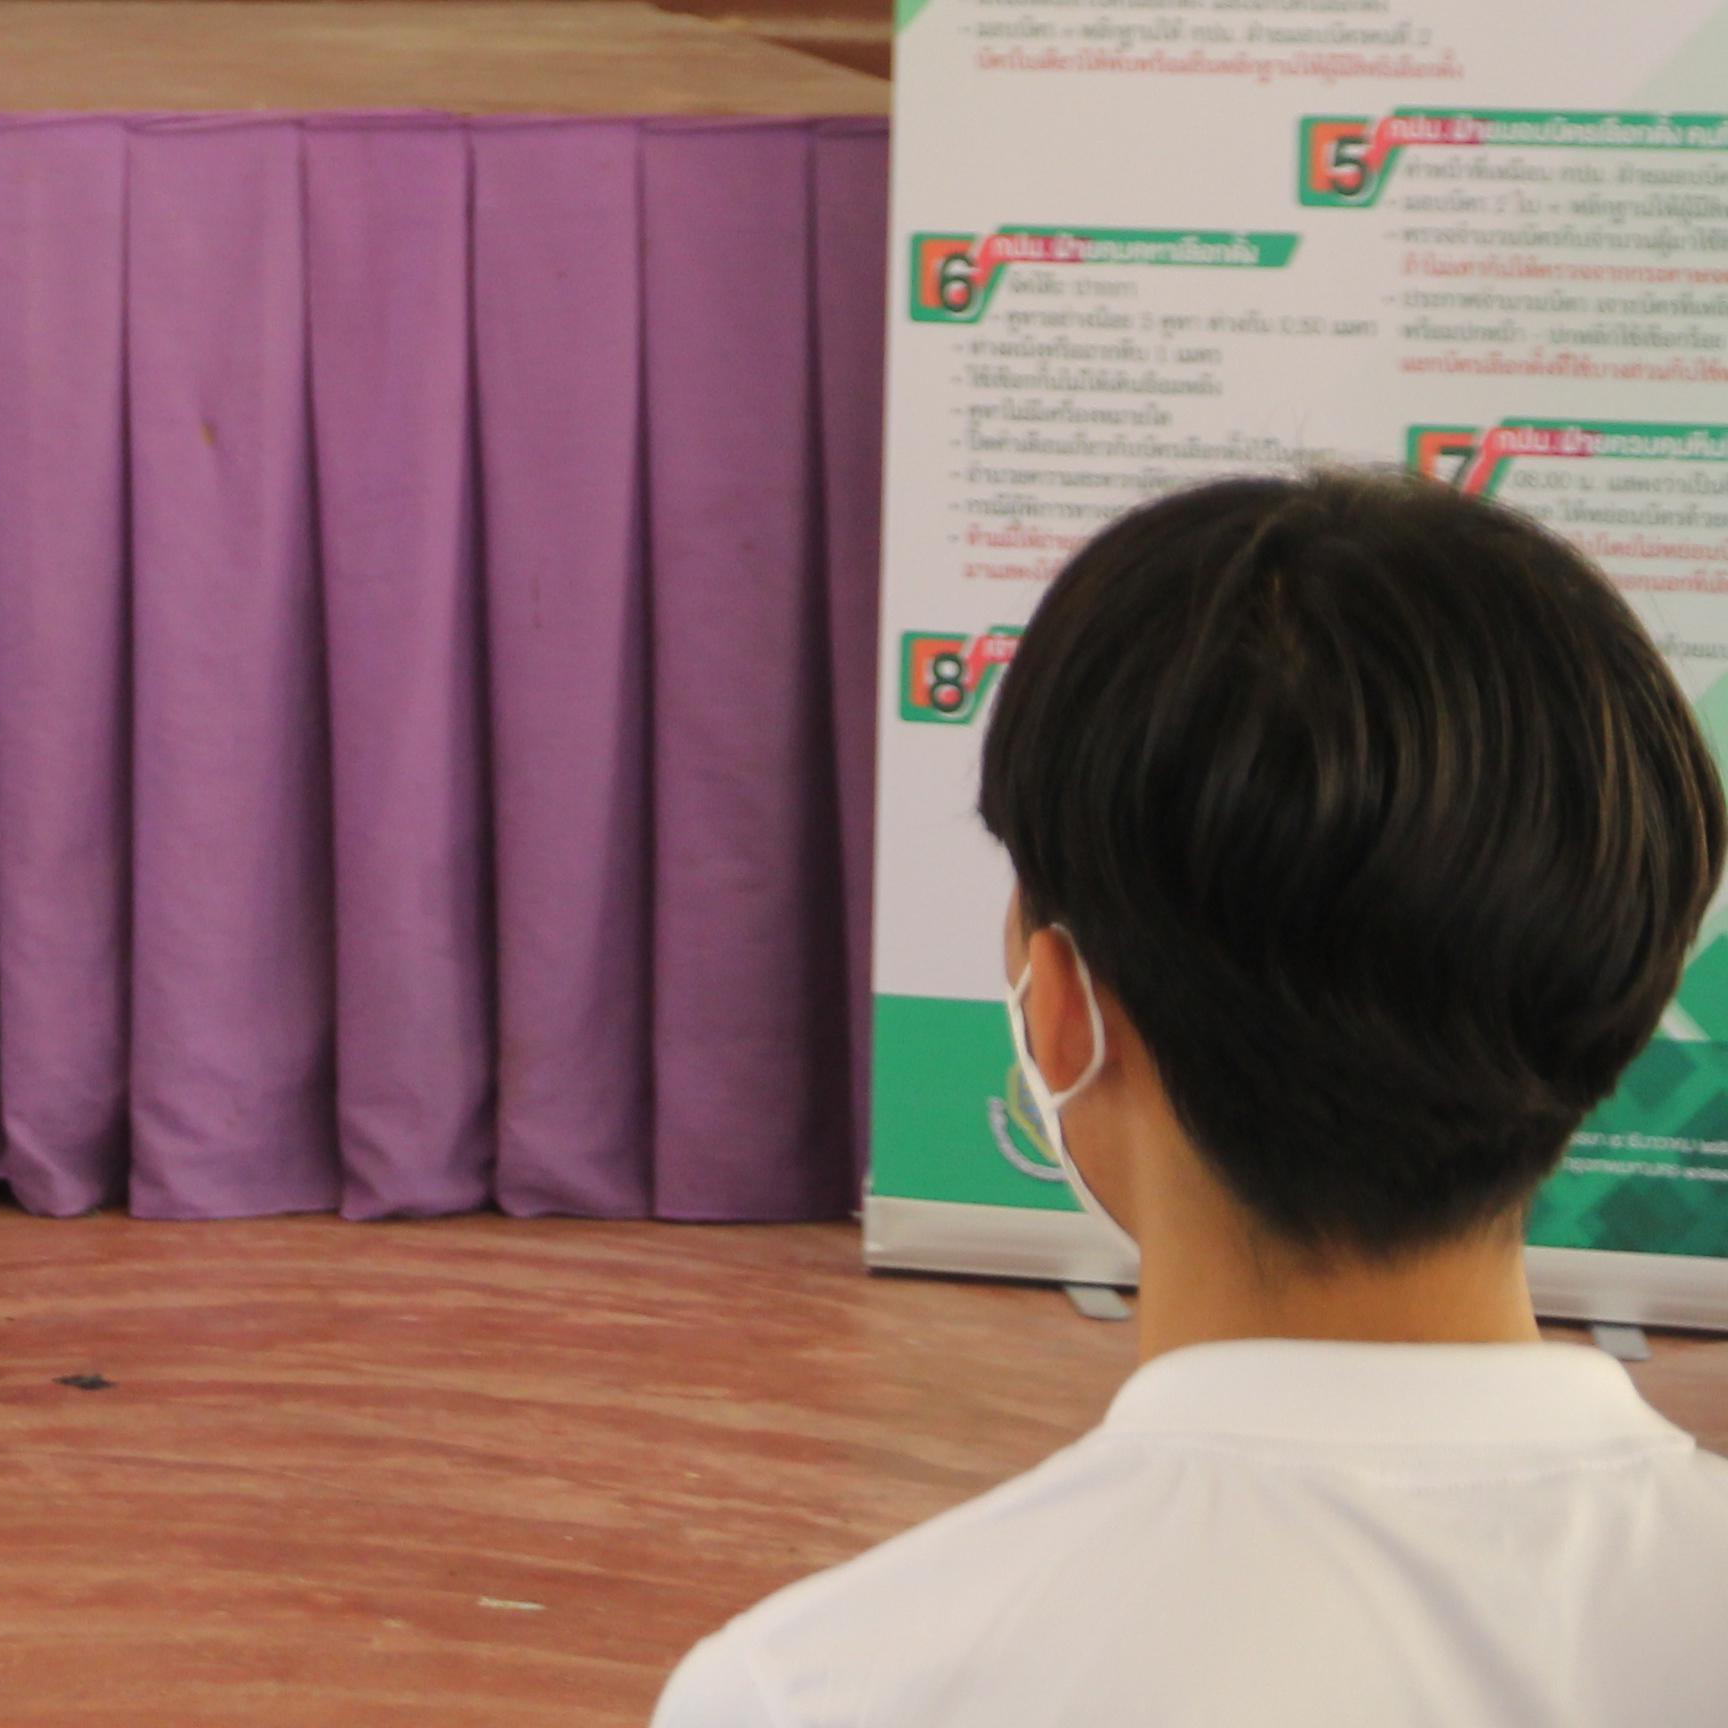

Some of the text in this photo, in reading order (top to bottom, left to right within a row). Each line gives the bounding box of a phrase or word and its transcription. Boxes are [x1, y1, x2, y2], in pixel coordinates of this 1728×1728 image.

[1328, 135, 1372, 197] 5
[938, 252, 974, 313] 6
[931, 652, 965, 712] 8
